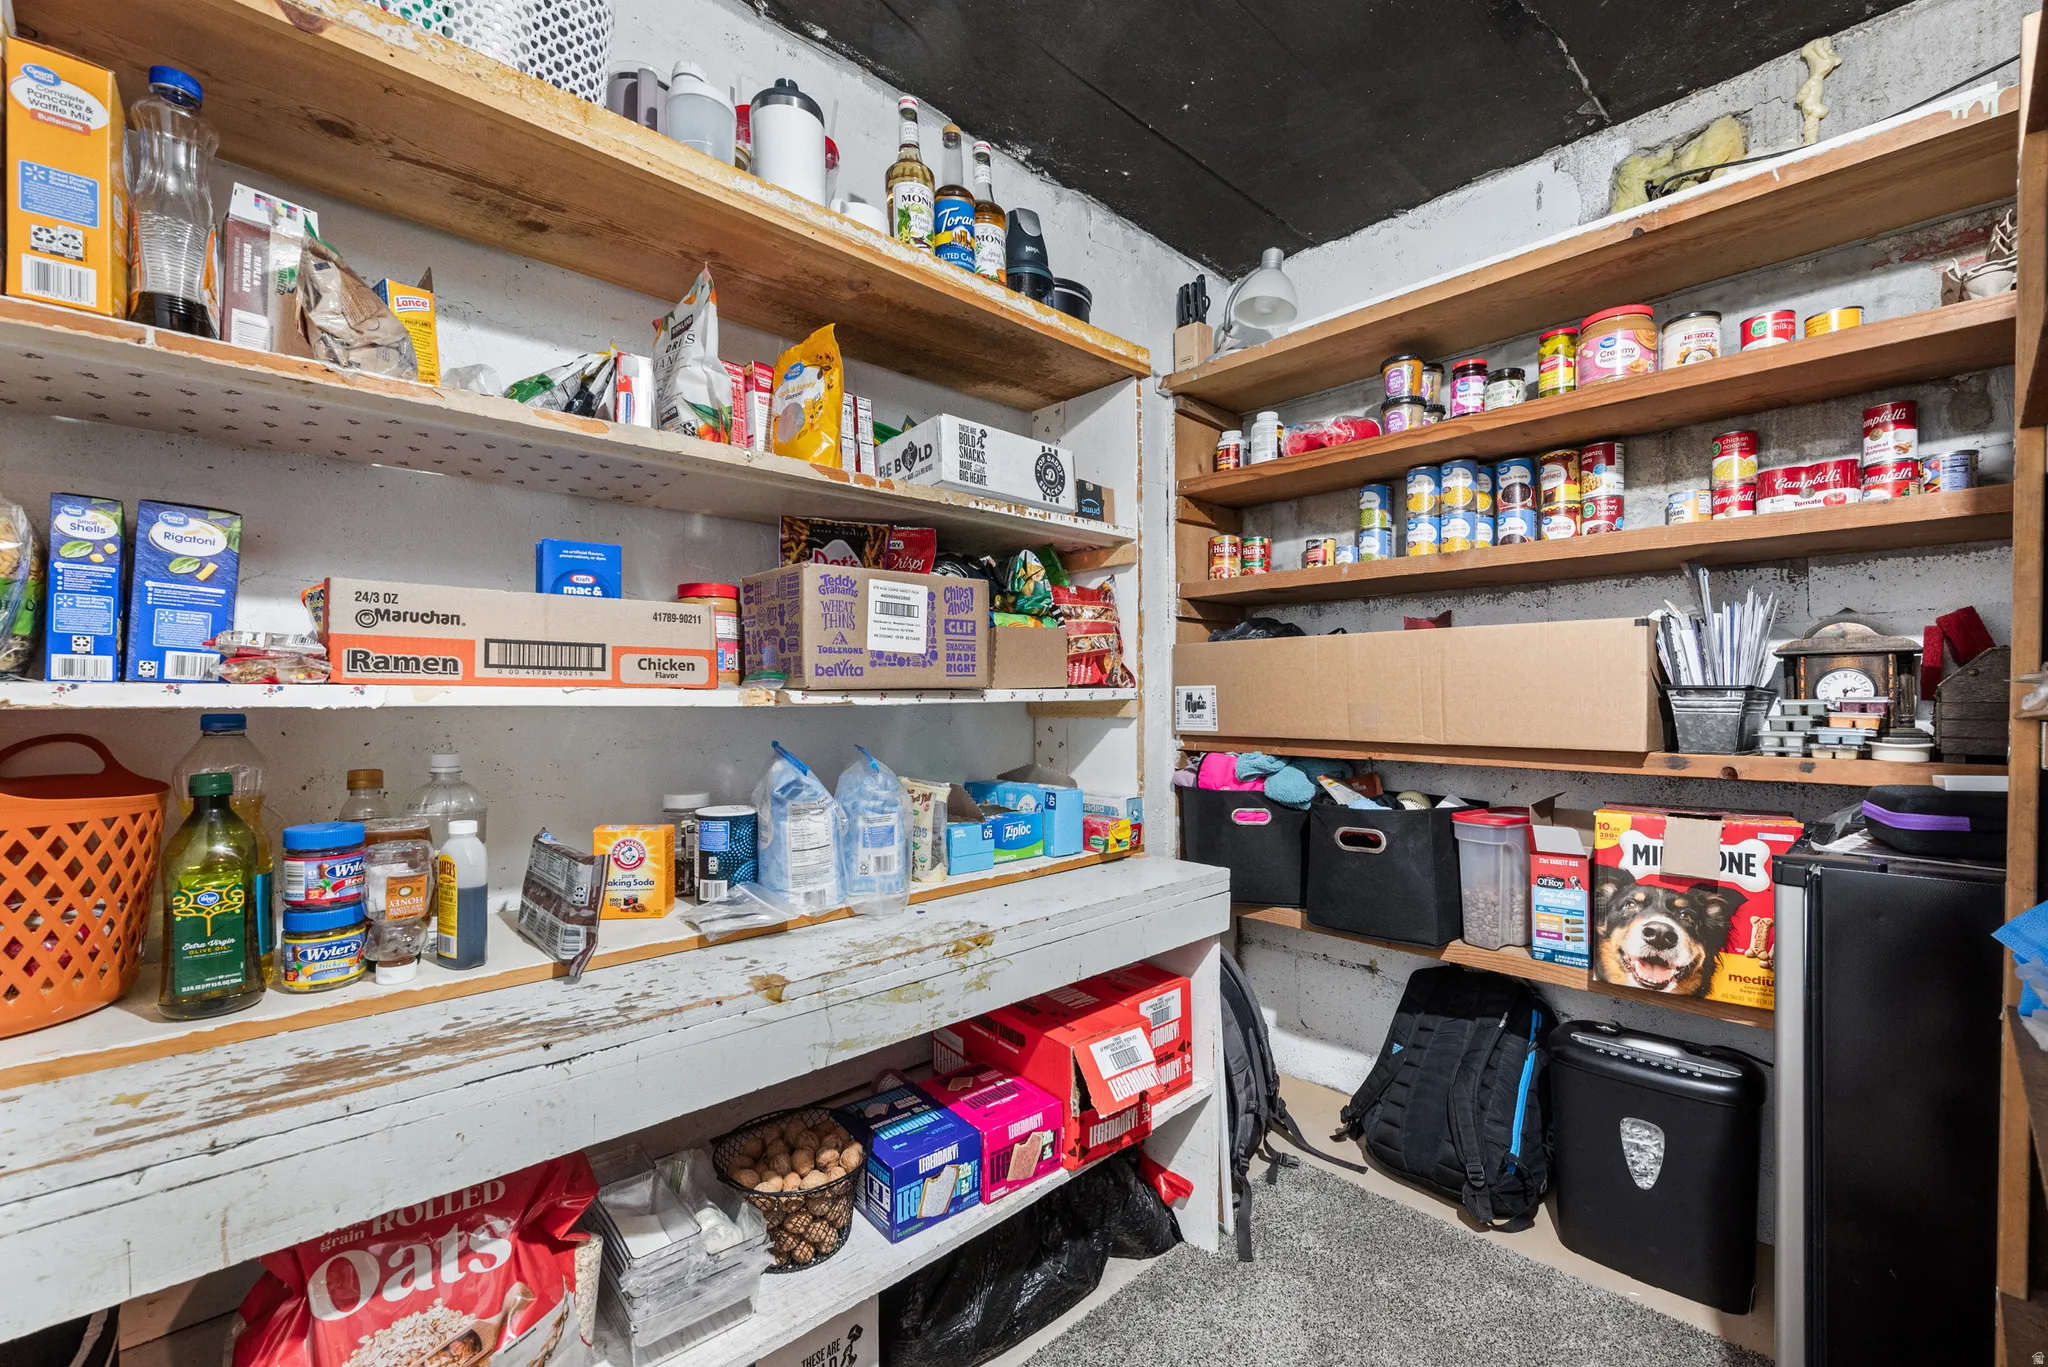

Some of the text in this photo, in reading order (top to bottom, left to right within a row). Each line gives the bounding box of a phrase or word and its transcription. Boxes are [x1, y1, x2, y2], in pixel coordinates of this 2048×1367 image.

[27, 87, 94, 115] Pancake &
[36, 84, 85, 104] Complete
[28, 97, 92, 123] Waffle Mix
[37, 112, 84, 131] Buttermilk
[938, 207, 975, 234] Toran
[242, 243, 252, 293] BROWN SUGAR
[253, 255, 262, 278] MAPLE
[395, 297, 428, 308] Lance
[1772, 322, 1788, 331] milk
[1684, 332, 1714, 340] HERDEZ
[1600, 347, 1635, 358] Cremy
[796, 381, 816, 390] Honey
[1863, 407, 1906, 428] ampbell's
[958, 424, 970, 433] THESE
[959, 432, 975, 447] BOLD
[1722, 436, 1748, 445] chicken
[1722, 441, 1747, 450] noodle
[959, 446, 988, 464] SNACKS.
[1866, 447, 1890, 456] Mushroom
[959, 460, 972, 471] MADE
[1037, 455, 1064, 476] POP DADDY
[959, 470, 988, 486] BIG HEART.
[1774, 469, 1841, 489] Campbell's
[1039, 481, 1062, 495] SNACKS
[1597, 504, 1618, 512] kidney
[1794, 499, 1821, 507] Tomato
[1082, 506, 1101, 516] prime
[77, 518, 98, 526] Small
[163, 514, 185, 523] Great
[70, 523, 106, 534] Shells
[1546, 524, 1571, 532] Refried
[163, 532, 216, 547] Rigatoni
[1243, 547, 1265, 556] Hunt's
[819, 574, 857, 589] Teddy
[355, 591, 398, 604] 24/3 OZ
[563, 586, 602, 596] mac &
[818, 585, 859, 598] Grahams
[944, 586, 969, 604] Chips
[820, 600, 855, 613] WHEAT
[948, 594, 974, 616] Ahoy!
[375, 608, 461, 626] Maruchan
[652, 612, 701, 625] 41789-90211
[948, 622, 974, 633] CLIF
[817, 645, 863, 654] TOBLERONE
[946, 643, 976, 652] SNACKING
[347, 649, 459, 675] Ramen
[946, 653, 976, 662] MADE
[637, 658, 695, 672] Chicken
[815, 659, 863, 677] belVita
[946, 663, 976, 673] RIGHT
[1005, 824, 1031, 840] Ziploc
[1597, 821, 1610, 831] 10
[625, 840, 645, 858] HAMMER
[607, 878, 655, 888] aking Soda
[200, 894, 217, 903] Kroger
[389, 896, 423, 908] HONEY
[182, 938, 236, 951] Extra Virgin
[306, 943, 358, 961] Wyler's
[312, 960, 349, 972] Chicken
[1728, 973, 1775, 987] mediu
[1107, 1062, 1164, 1103] LEGENDARY!
[874, 1110, 944, 1141] LEGENDARY!
[1008, 1111, 1043, 1140] LEGENDARY!
[1089, 1106, 1140, 1149] LEGENDARY!
[919, 1142, 959, 1175] LEGENDARY!
[371, 1179, 506, 1236] ROLLED
[896, 1221, 925, 1238] BLUEBERRY
[320, 1229, 365, 1252] grain
[307, 1219, 514, 1321] Oats
[801, 1338, 841, 1367] THESE ARE
